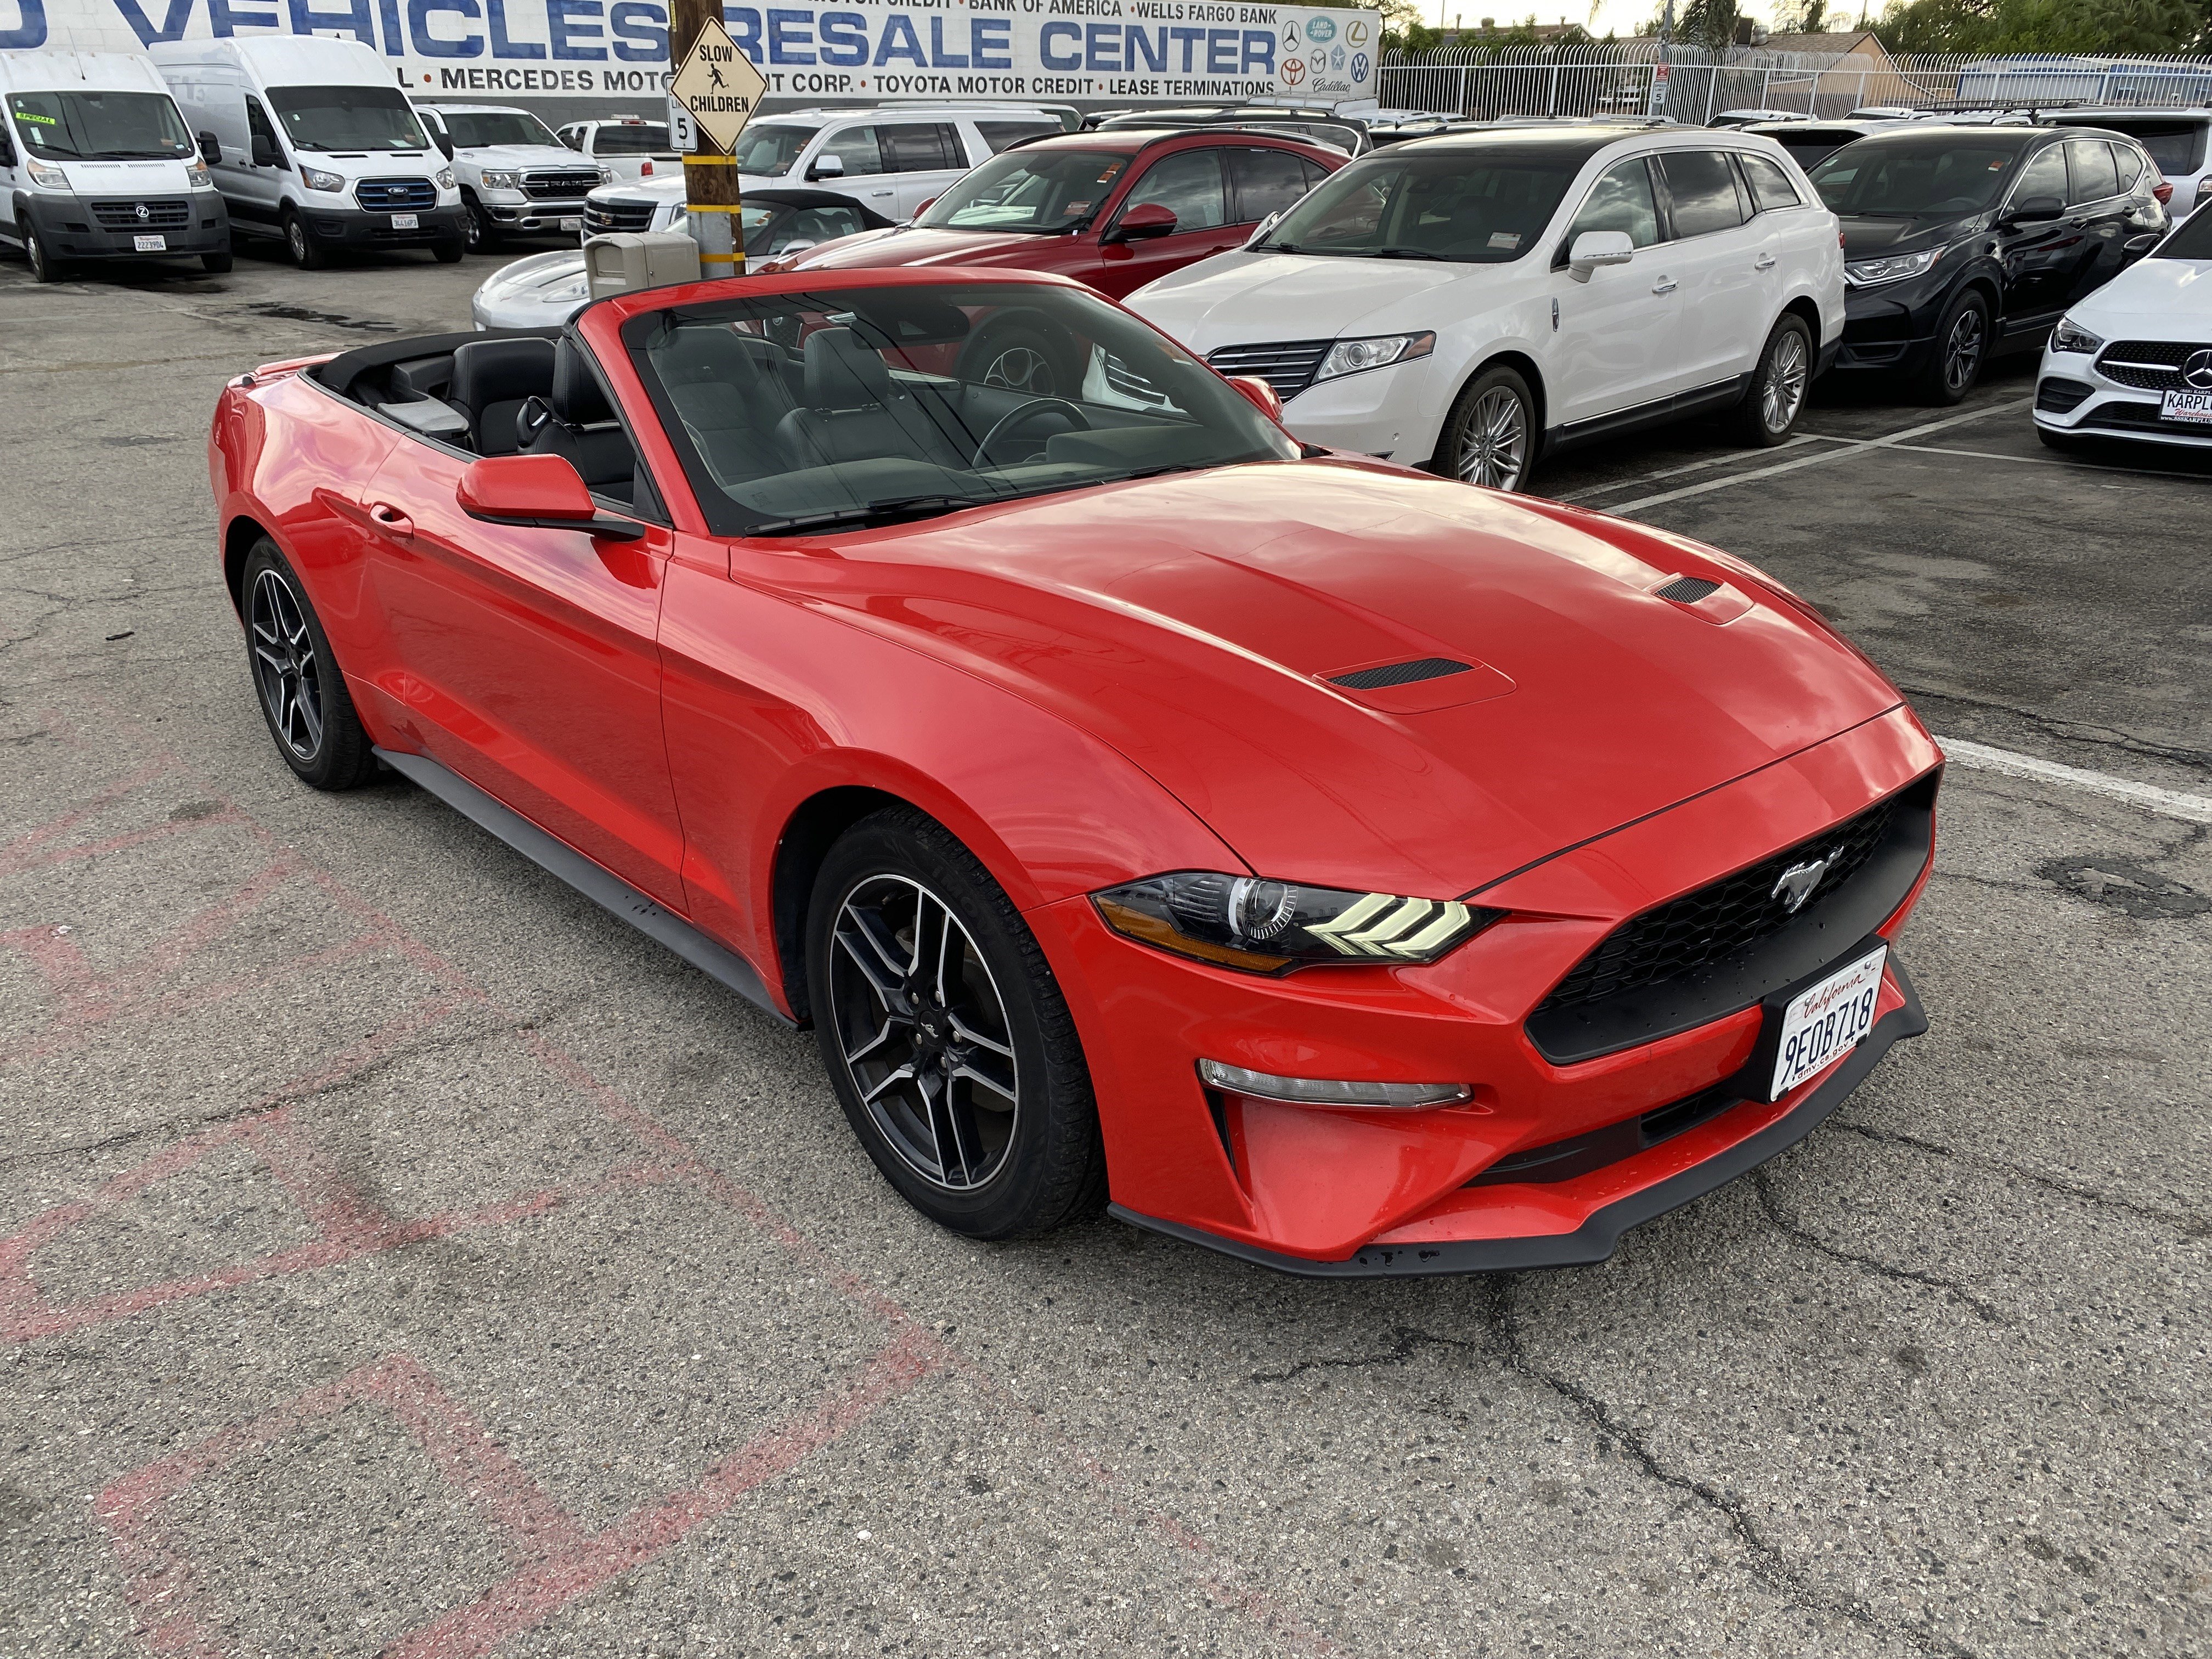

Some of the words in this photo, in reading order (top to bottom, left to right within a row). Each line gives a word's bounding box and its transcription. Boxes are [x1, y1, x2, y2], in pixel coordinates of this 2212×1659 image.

[1048, 0, 1122, 16] AMERICA
[1136, 1, 1184, 20] WELLS
[1188, 4, 1235, 22] FARGO
[1240, 8, 1277, 24] BANK
[723, 6, 1012, 69] RESALE
[1040, 21, 1276, 75] CENTER
[1313, 30, 1333, 38] ROVER
[699, 44, 732, 62] SLOW
[441, 67, 594, 91] MERCEDES
[792, 73, 854, 93] CORP.
[873, 75, 952, 93] TOYOTA
[957, 76, 1025, 94] MOTOR
[1032, 77, 1094, 94] CREDIT
[1109, 79, 1159, 95] LEASE
[1164, 80, 1274, 96] TERMINATIONS
[1312, 78, 1351, 93] Cadillac
[690, 95, 749, 112] CHILDREN
[677, 117, 688, 140] 5
[2174, 408, 2212, 417] Warehous
[1804, 970, 1866, 1019] California
[1797, 1041, 1849, 1080] dmv.ca.gov
